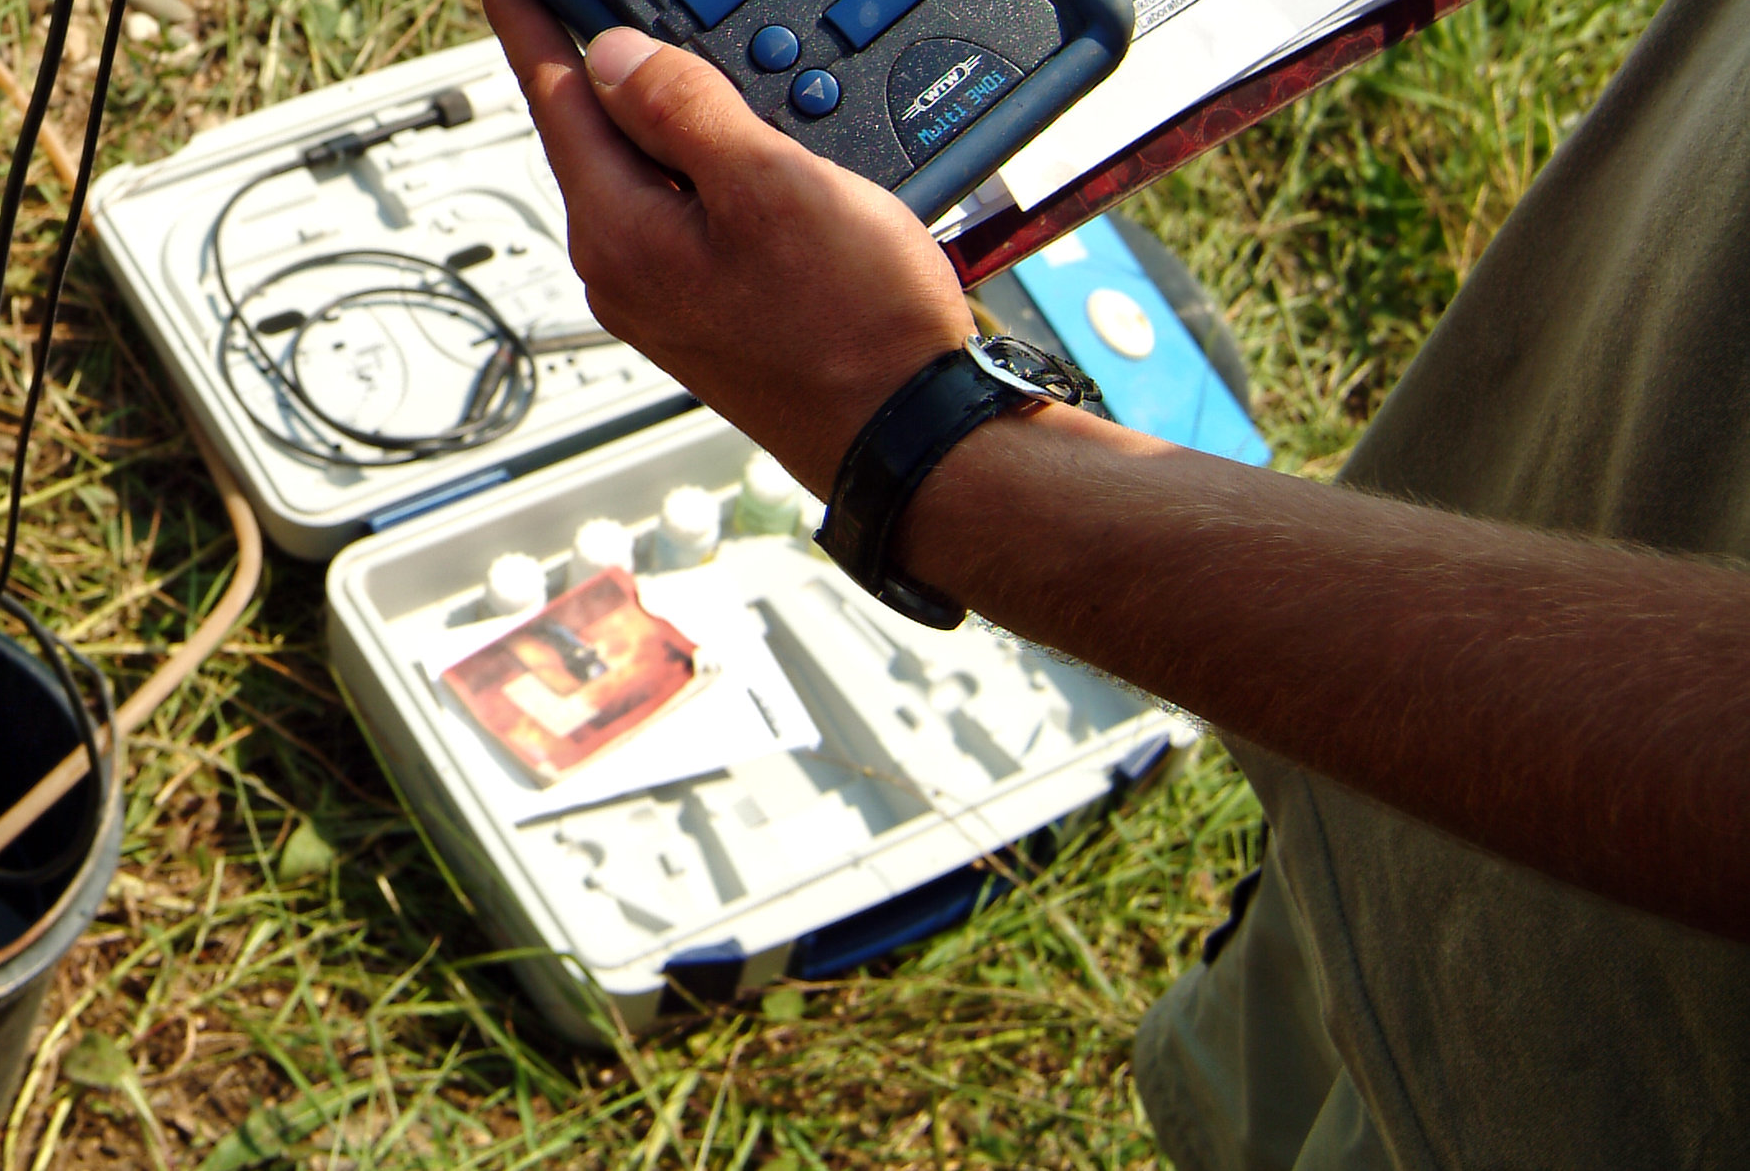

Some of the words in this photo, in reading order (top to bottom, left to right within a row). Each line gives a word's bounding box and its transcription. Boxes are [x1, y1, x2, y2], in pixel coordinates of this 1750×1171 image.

[916, 102, 967, 147] Multi
[969, 70, 1006, 106] 340i
[922, 69, 961, 101] WTW
